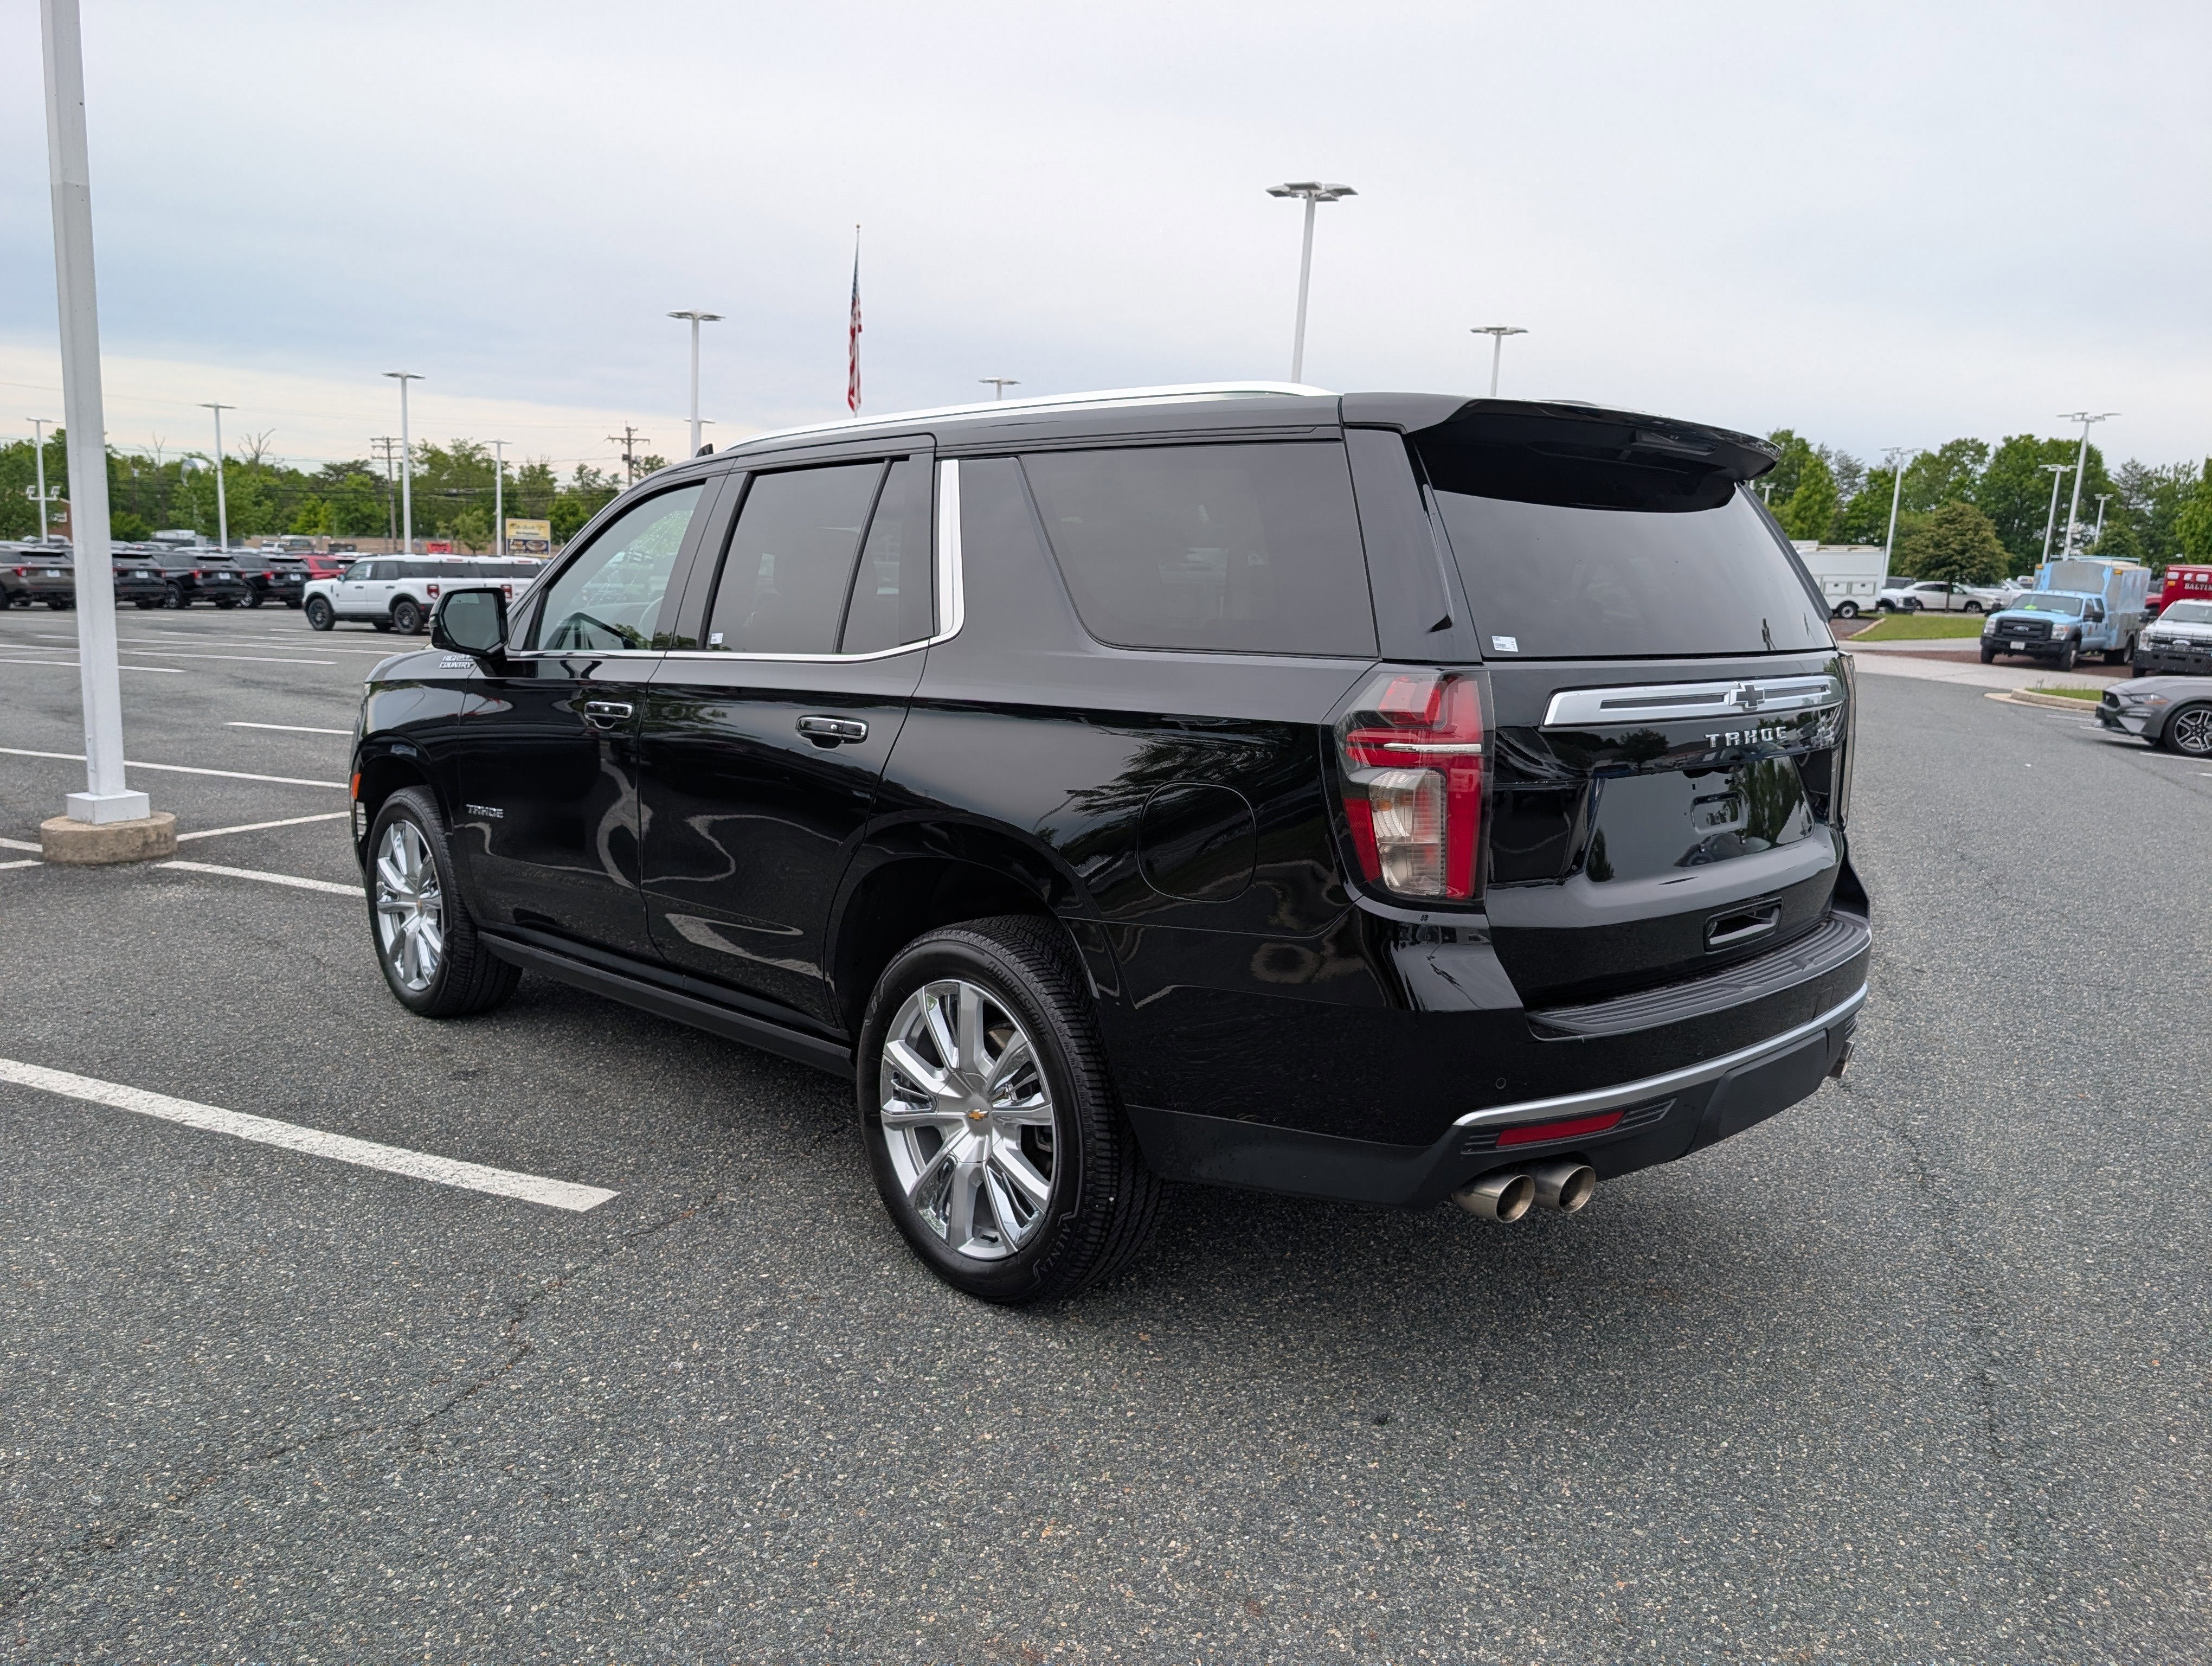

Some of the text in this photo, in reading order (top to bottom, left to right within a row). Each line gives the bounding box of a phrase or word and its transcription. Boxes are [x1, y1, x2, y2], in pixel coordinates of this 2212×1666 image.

[1705, 726, 1787, 748] TAHOE
[466, 804, 504, 818] TAHOE
[984, 960, 1051, 1041] BRIDGESTONE
[1040, 1222, 1071, 1273] ALENZA
